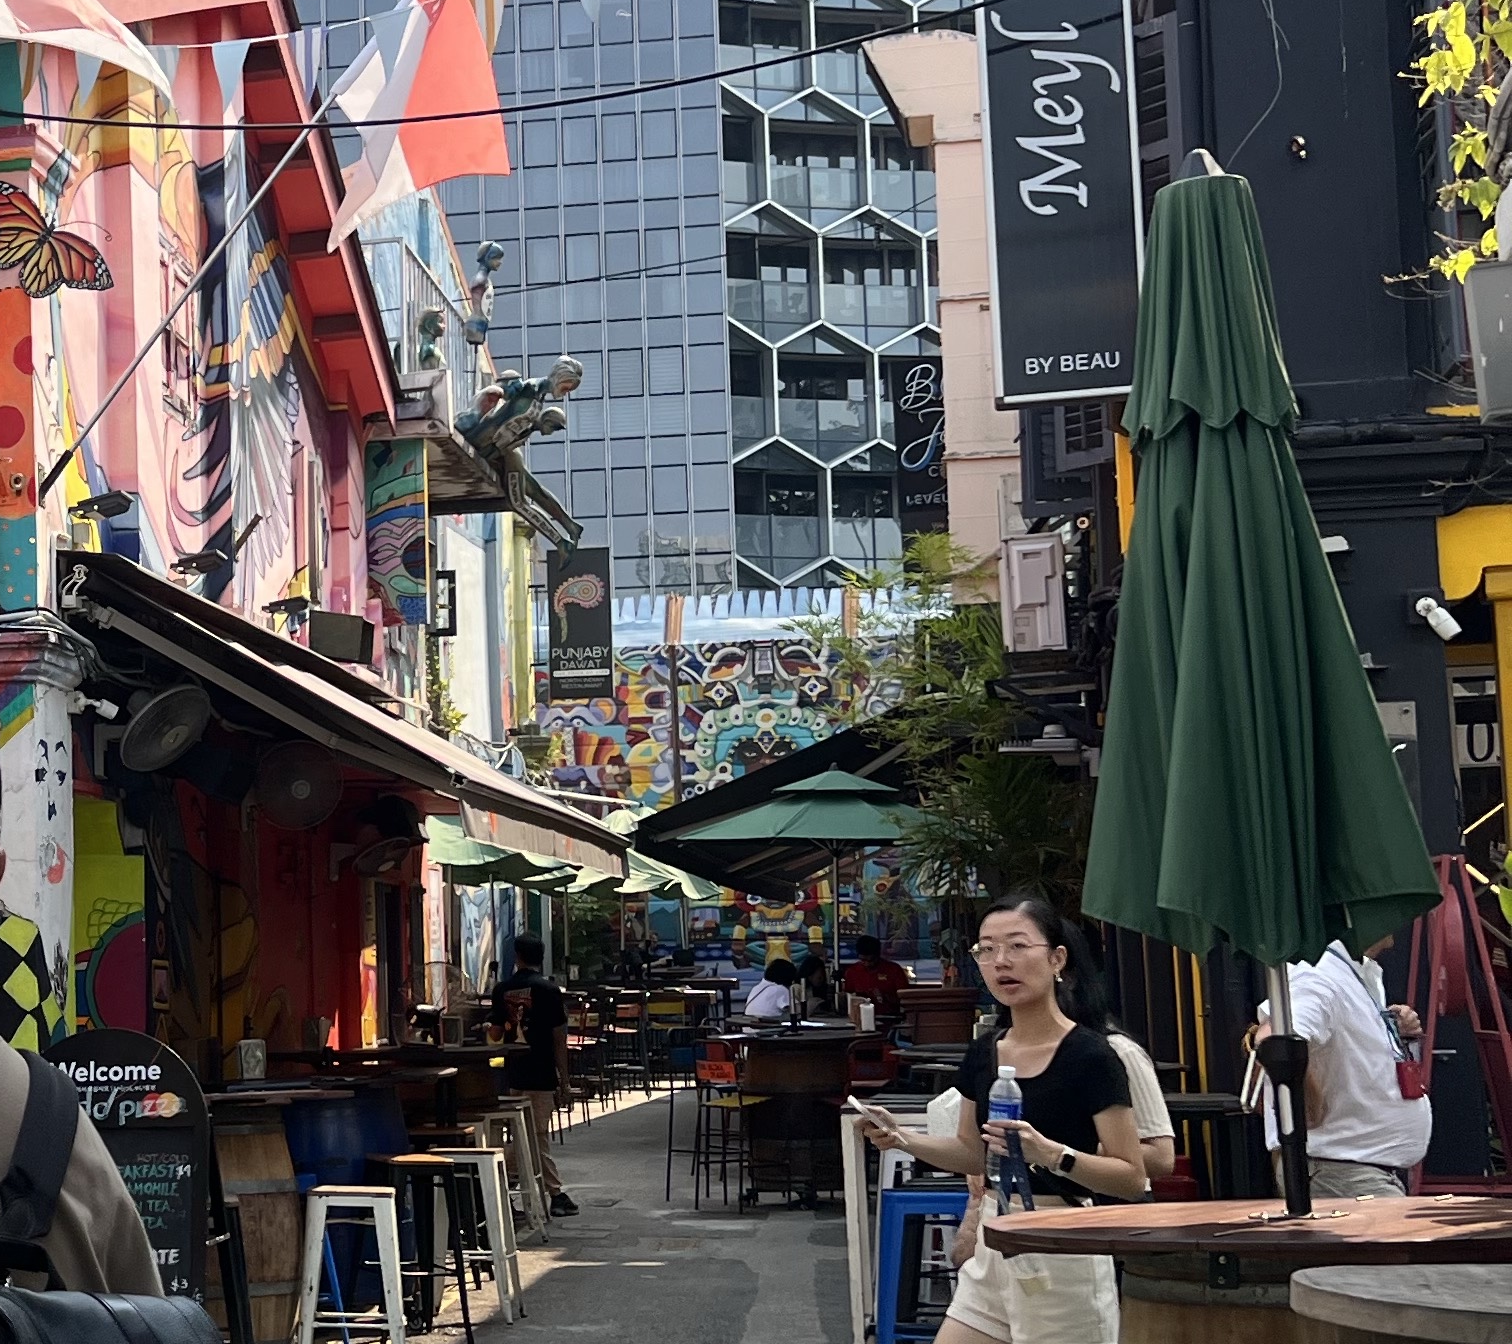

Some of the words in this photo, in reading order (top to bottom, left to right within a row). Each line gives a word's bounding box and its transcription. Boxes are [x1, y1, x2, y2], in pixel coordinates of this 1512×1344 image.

[1025, 357, 1053, 375] BY
[1060, 351, 1121, 373] BEAU
[552, 646, 609, 660] PUNJABY
[560, 659, 602, 670] DAWAT
[49, 1060, 162, 1082] Welcome
